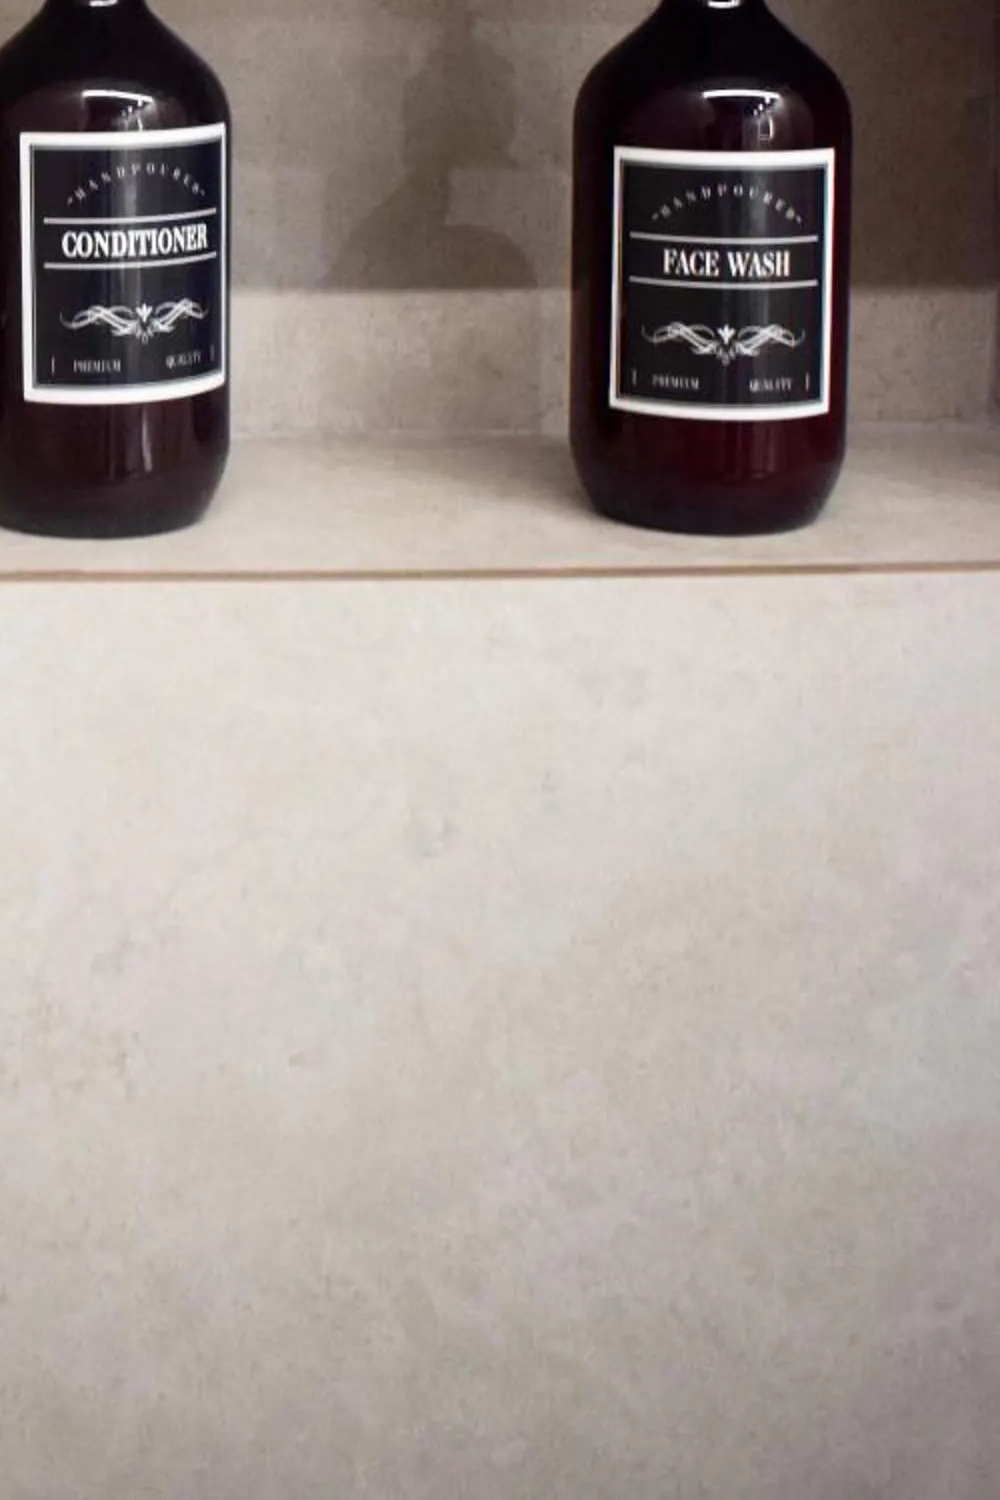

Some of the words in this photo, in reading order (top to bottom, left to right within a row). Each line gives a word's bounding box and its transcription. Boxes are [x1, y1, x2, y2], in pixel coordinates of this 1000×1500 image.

[61, 223, 208, 258] CONDITIONER
[663, 249, 720, 275] FACE
[727, 251, 790, 277] WASH
[73, 359, 121, 373] PREMIUM
